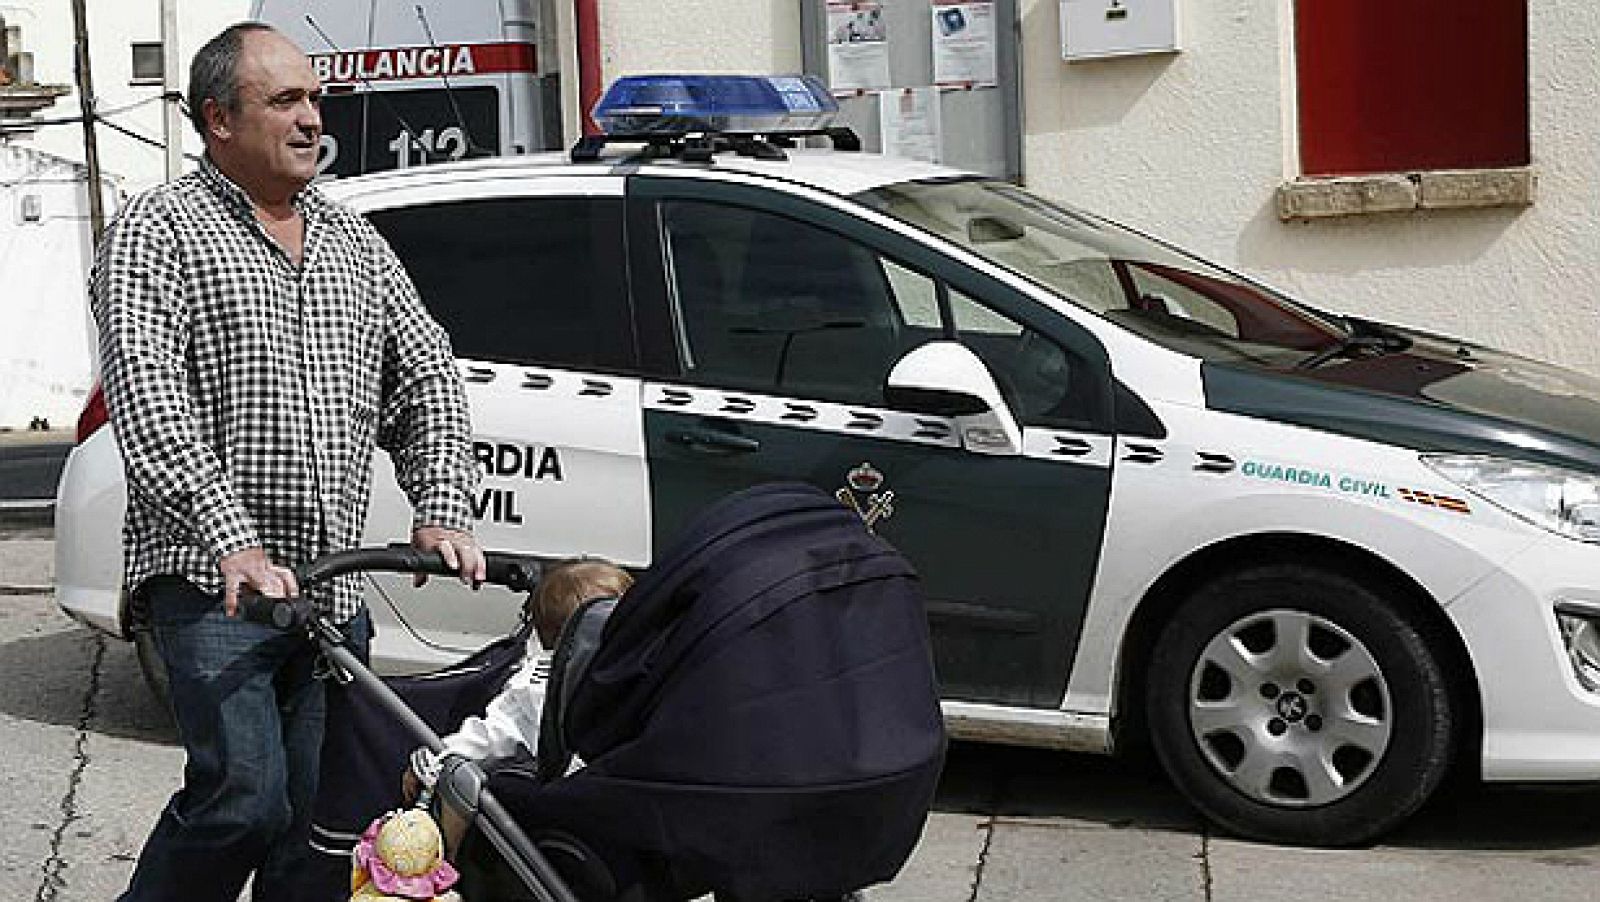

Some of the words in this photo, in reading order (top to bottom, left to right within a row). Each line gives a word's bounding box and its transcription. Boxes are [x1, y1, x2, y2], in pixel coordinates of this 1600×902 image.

[315, 46, 474, 81] BULANCIA
[473, 441, 562, 481] RDIA
[1242, 461, 1331, 487] GUARDIA
[1339, 478, 1390, 498] CIVIL
[470, 488, 522, 525] VIL
